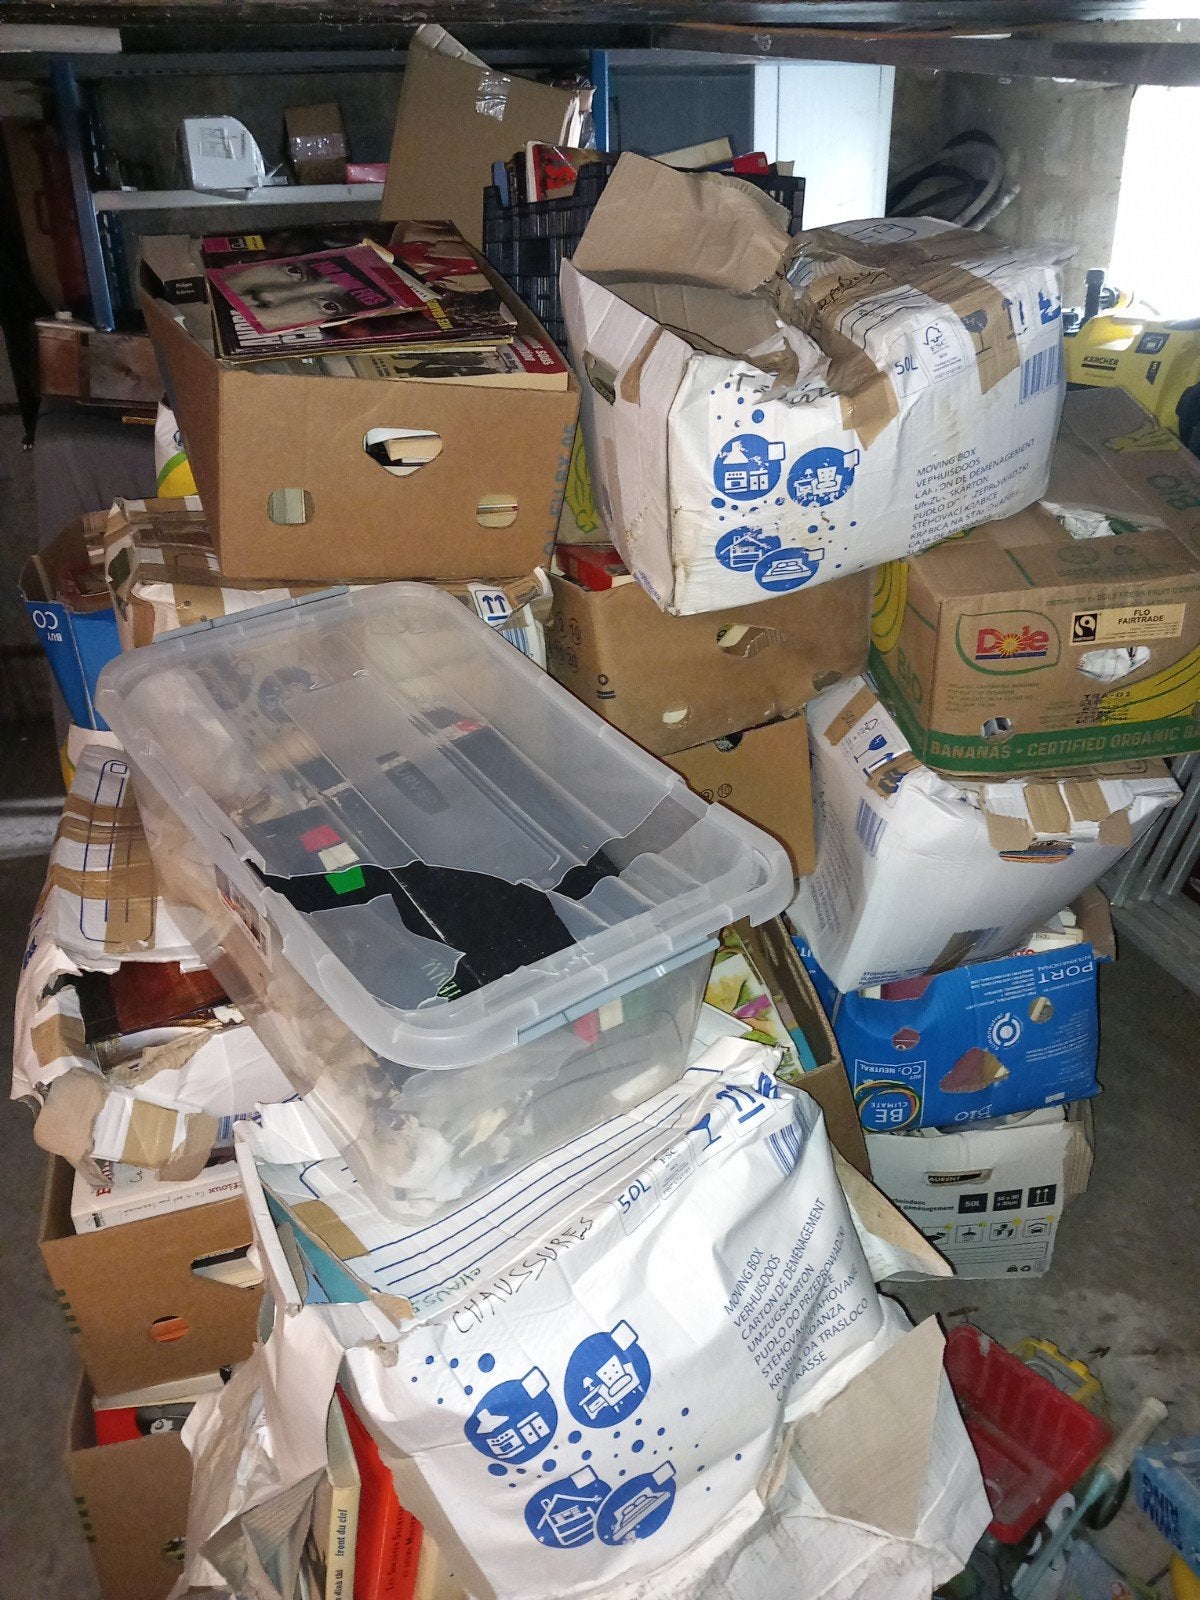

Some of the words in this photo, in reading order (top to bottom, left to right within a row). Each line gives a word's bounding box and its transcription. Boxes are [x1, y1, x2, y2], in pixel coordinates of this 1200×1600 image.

[893, 356, 919, 376] 50L
[917, 457, 956, 477] MOVING
[957, 447, 977, 462] BOX
[954, 475, 968, 486] DE
[1118, 615, 1164, 625] FAIRTRADE
[1133, 608, 1151, 617] FLO
[976, 625, 1050, 655] Dole
[930, 741, 1011, 759] BANANAS
[1027, 736, 1104, 757] CERTIFIED
[1110, 727, 1181, 748] ORGANIC
[1037, 961, 1093, 984] PORT
[860, 1064, 896, 1074] NEUTRAL
[875, 1108, 903, 1123] BE
[618, 1178, 652, 1215] 50L
[451, 1216, 594, 1334] CHAUSSURES
[723, 1268, 751, 1316] MOVING
[749, 1246, 765, 1270] BOX
[733, 1253, 781, 1329] VERHUISDOOS
[740, 1294, 778, 1341] CARTON
[775, 1280, 788, 1297] DE
[747, 1264, 815, 1353] UMZUGSKARTON
[785, 1308, 801, 1329] DO
[820, 1296, 869, 1344] TRASLOCO
[336, 1524, 347, 1536] du
